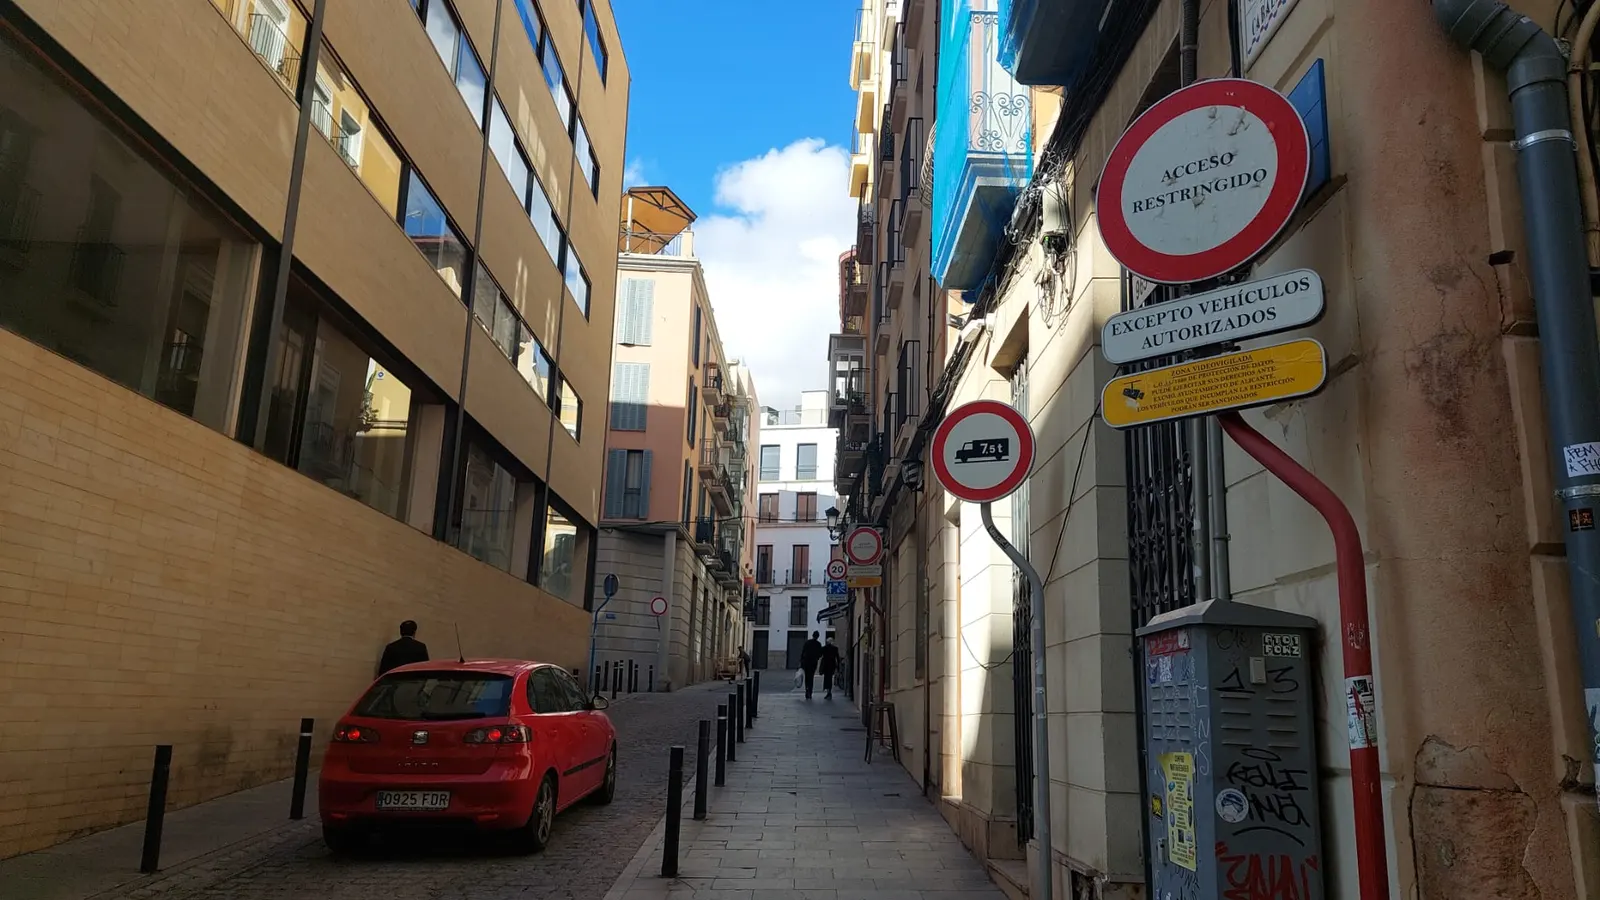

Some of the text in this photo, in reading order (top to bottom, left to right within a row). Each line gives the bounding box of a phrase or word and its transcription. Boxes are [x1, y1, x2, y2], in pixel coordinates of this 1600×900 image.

[1160, 152, 1235, 183] ACCESO
[1132, 168, 1268, 214] RESTRINGIDO
[1111, 276, 1310, 336] EXCEPTO VEHÍCULOS
[1141, 306, 1277, 350] AUTORIZADOS
[1171, 354, 1253, 377] ZONA VIDEOVIGILADA
[831, 565, 844, 574] 20
[384, 792, 418, 806] 0925
[422, 793, 448, 806] FDR
